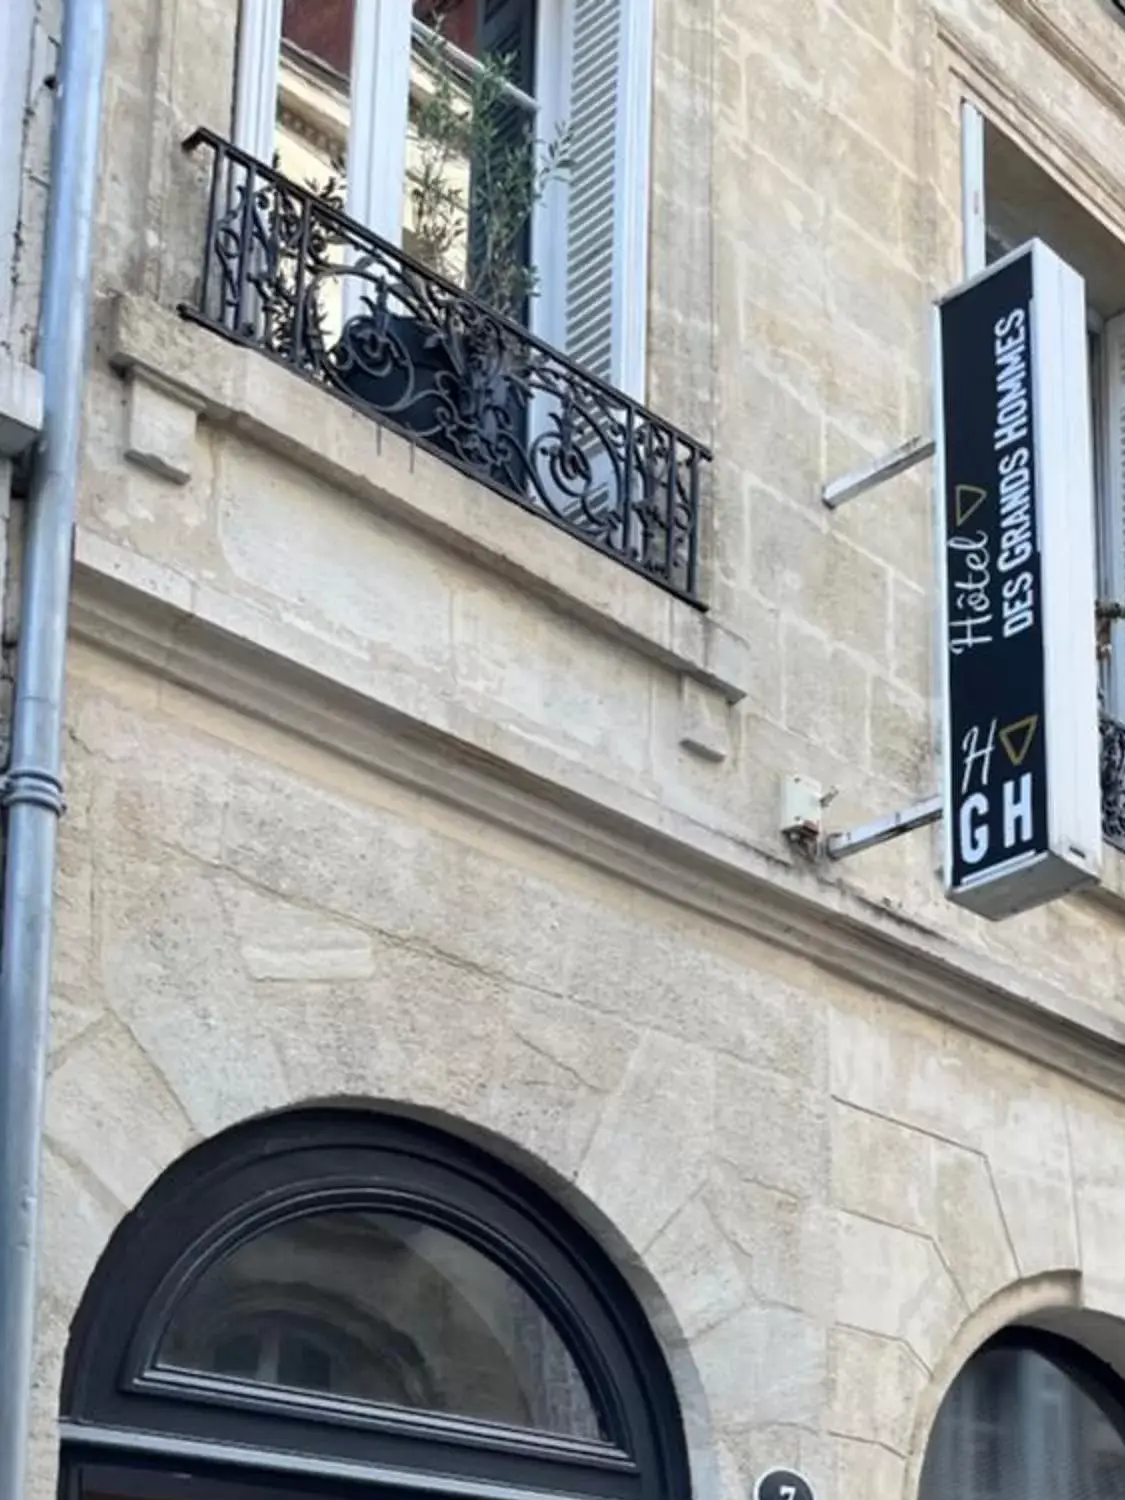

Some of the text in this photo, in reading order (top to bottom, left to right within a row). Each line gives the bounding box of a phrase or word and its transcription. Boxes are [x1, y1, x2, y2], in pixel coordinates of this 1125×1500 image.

[993, 307, 1035, 638] DES GRANDS HOMMES
[949, 529, 993, 655] Hôtel
[961, 717, 998, 795] H
